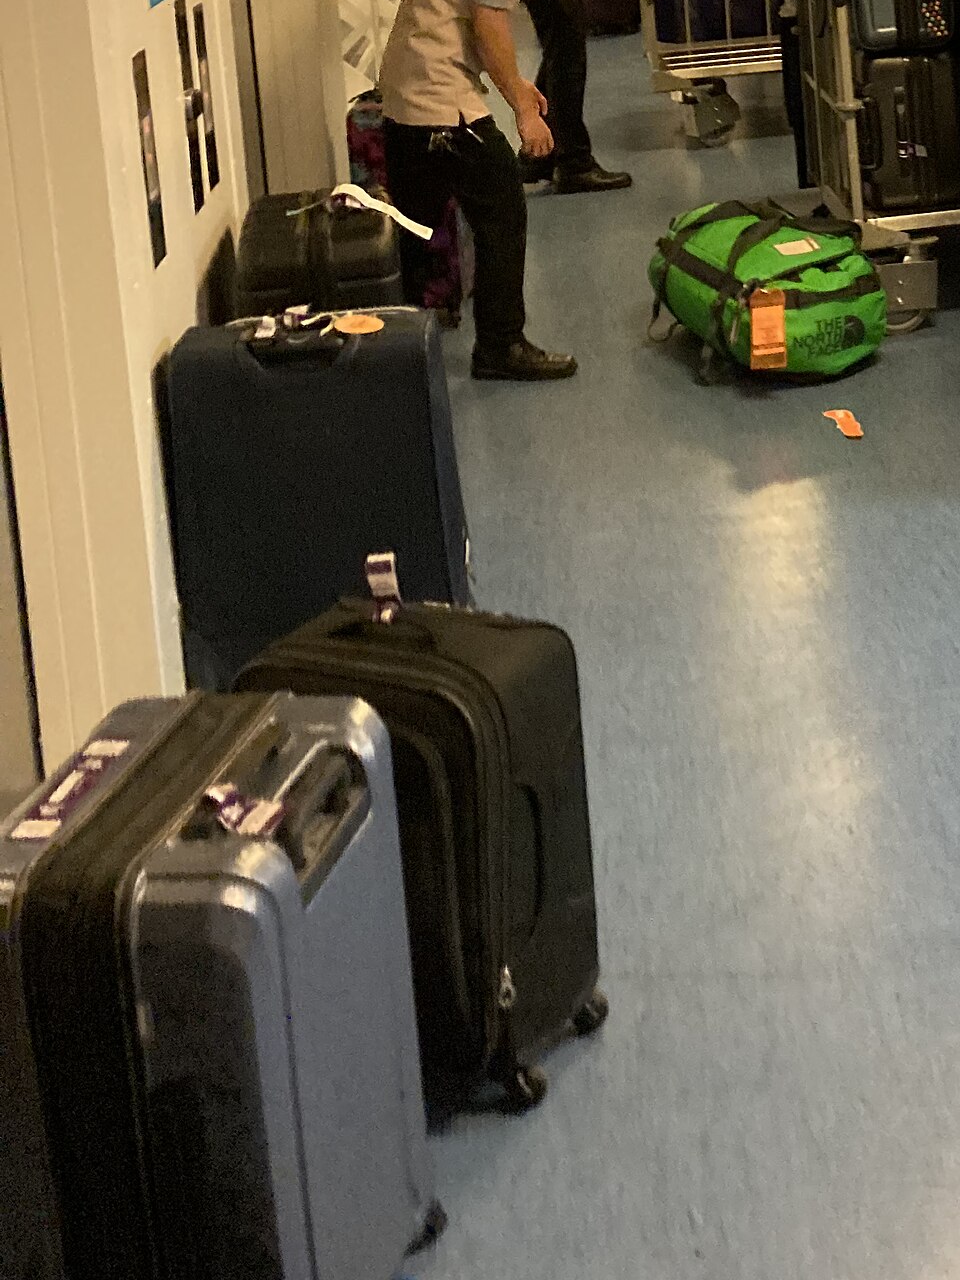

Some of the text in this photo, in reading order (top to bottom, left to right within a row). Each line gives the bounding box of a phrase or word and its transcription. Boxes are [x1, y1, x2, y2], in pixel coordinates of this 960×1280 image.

[815, 316, 843, 332] THE
[793, 329, 842, 348] NORTH
[807, 345, 843, 359] FACE
